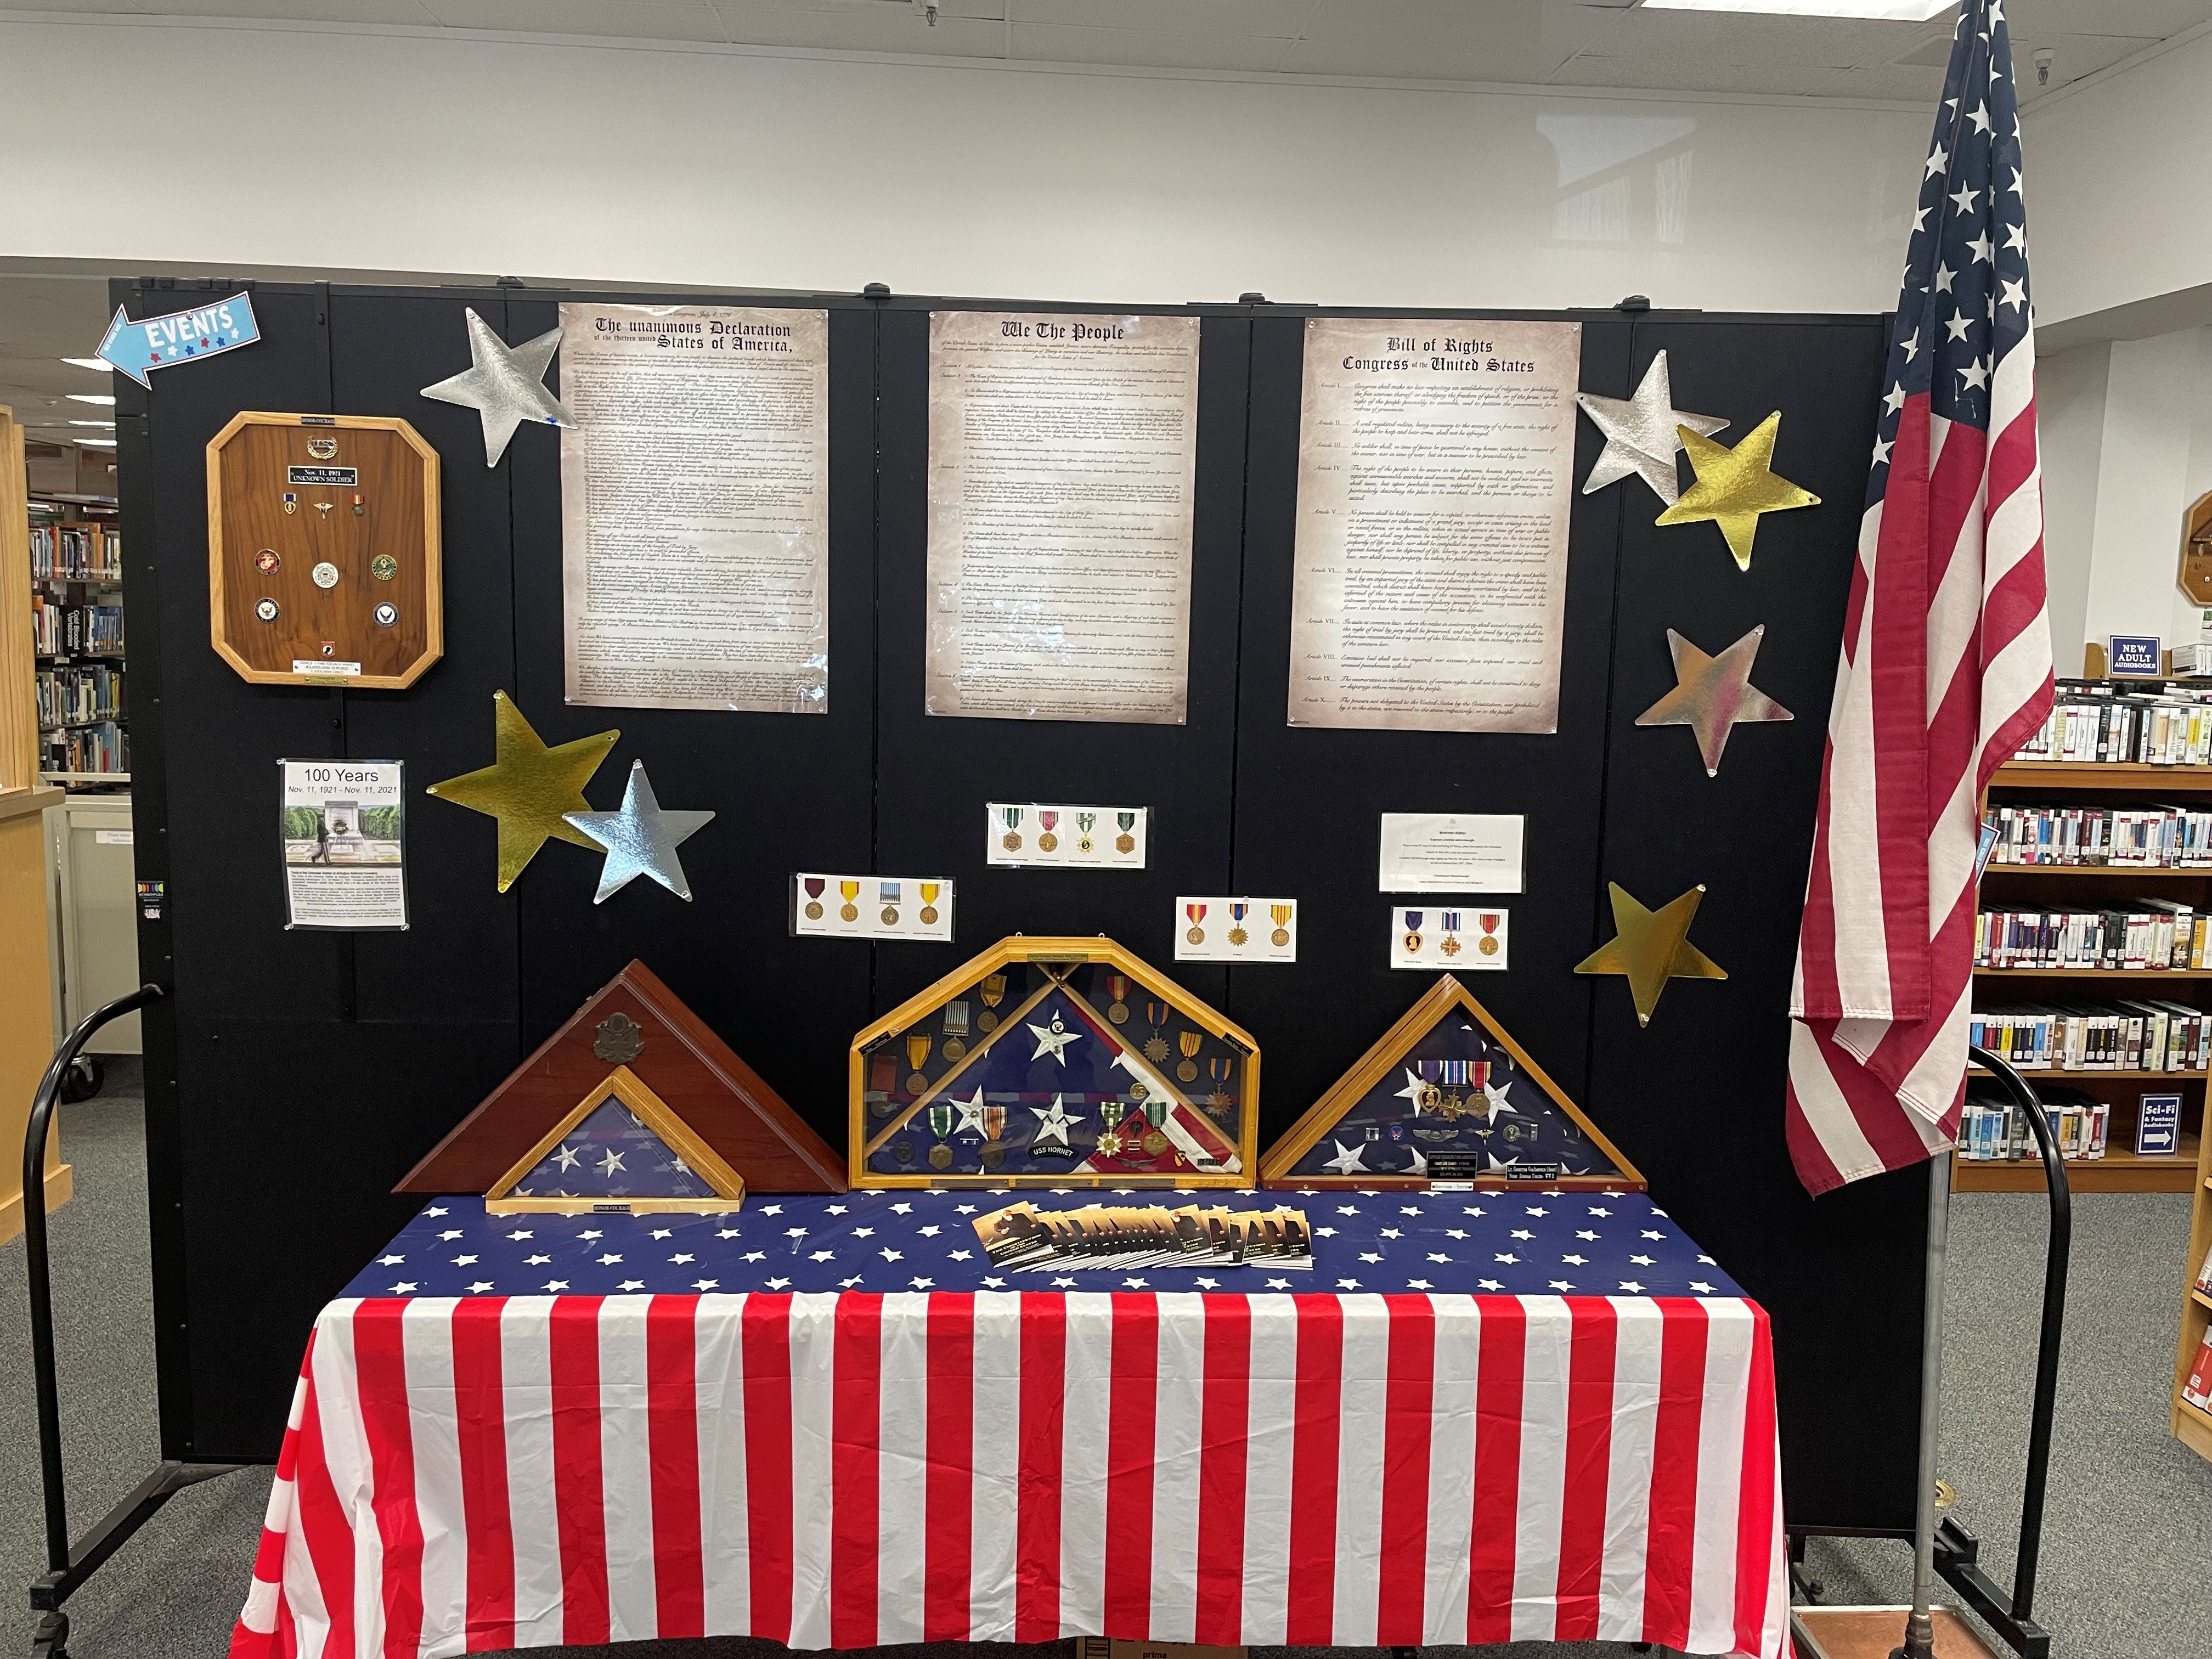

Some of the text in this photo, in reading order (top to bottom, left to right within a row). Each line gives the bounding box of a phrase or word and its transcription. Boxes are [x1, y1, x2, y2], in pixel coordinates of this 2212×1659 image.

[145, 305, 233, 348] EVENTS
[595, 318, 790, 336] The unanimous Declaration
[1001, 321, 1124, 342] We The People
[657, 334, 703, 348] States
[712, 336, 724, 349] of
[732, 336, 792, 353] America,
[1386, 337, 1493, 355] Bill of Rights
[1342, 356, 1408, 373] Congress
[1431, 357, 1478, 372] United
[1486, 359, 1534, 373] States
[2123, 644, 2147, 653] NEW
[2118, 653, 2152, 662] ADULT
[304, 769, 379, 782] 100 Years
[2146, 1104, 2175, 1114] Sci-Fi
[1048, 1147, 1074, 1157] HORNET
